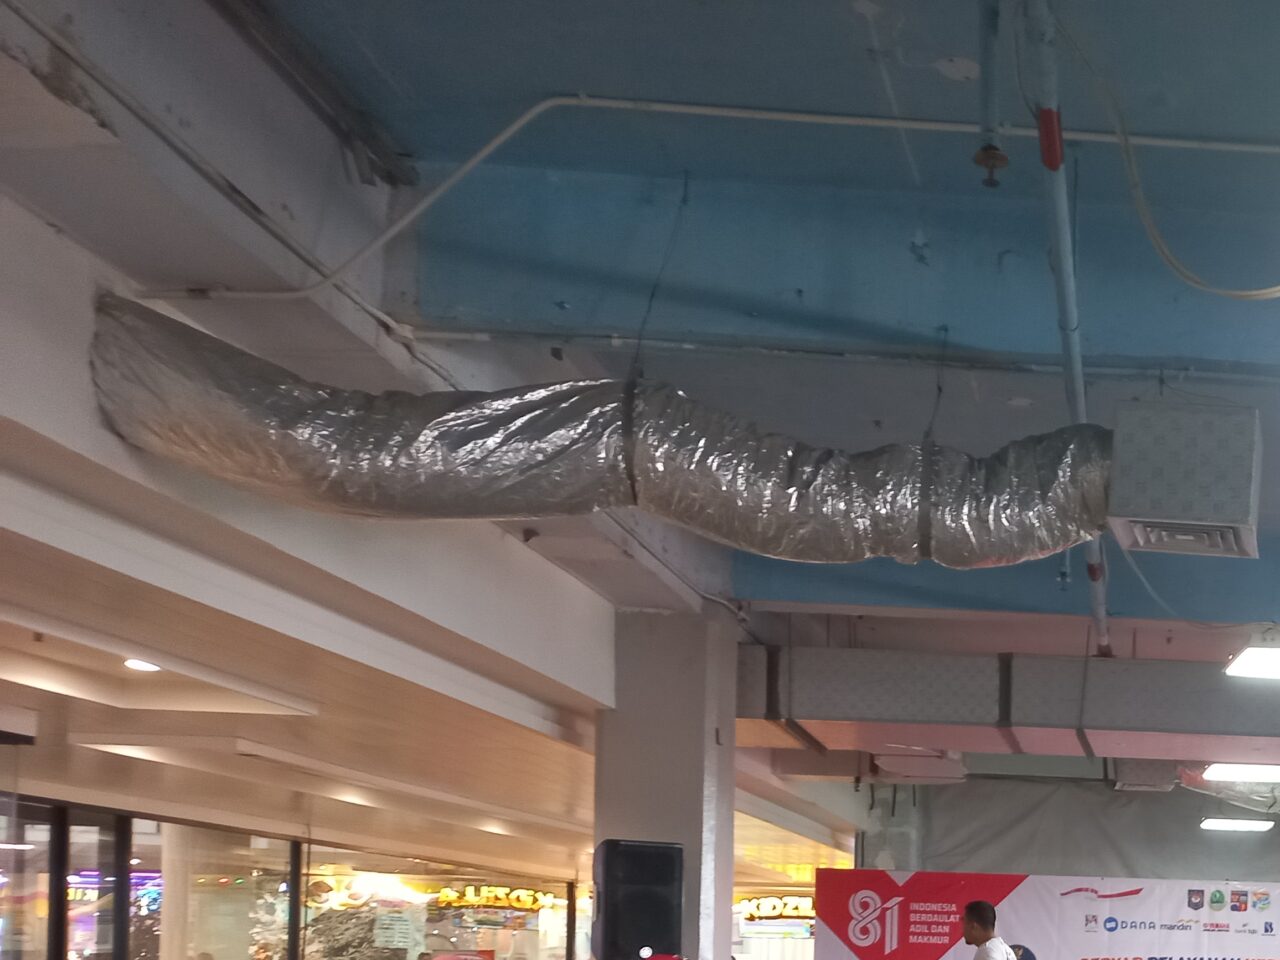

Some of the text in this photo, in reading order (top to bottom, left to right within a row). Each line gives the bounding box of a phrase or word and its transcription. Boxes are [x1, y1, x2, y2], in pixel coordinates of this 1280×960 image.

[909, 902, 957, 912] INDONESIA
[909, 913, 960, 922] BERDAULAT
[848, 889, 904, 956] 81
[1120, 920, 1156, 930] DANA
[1160, 922, 1192, 931] mandiri
[909, 924, 950, 933] ADIL DAN
[909, 935, 950, 944] MAKMUR
